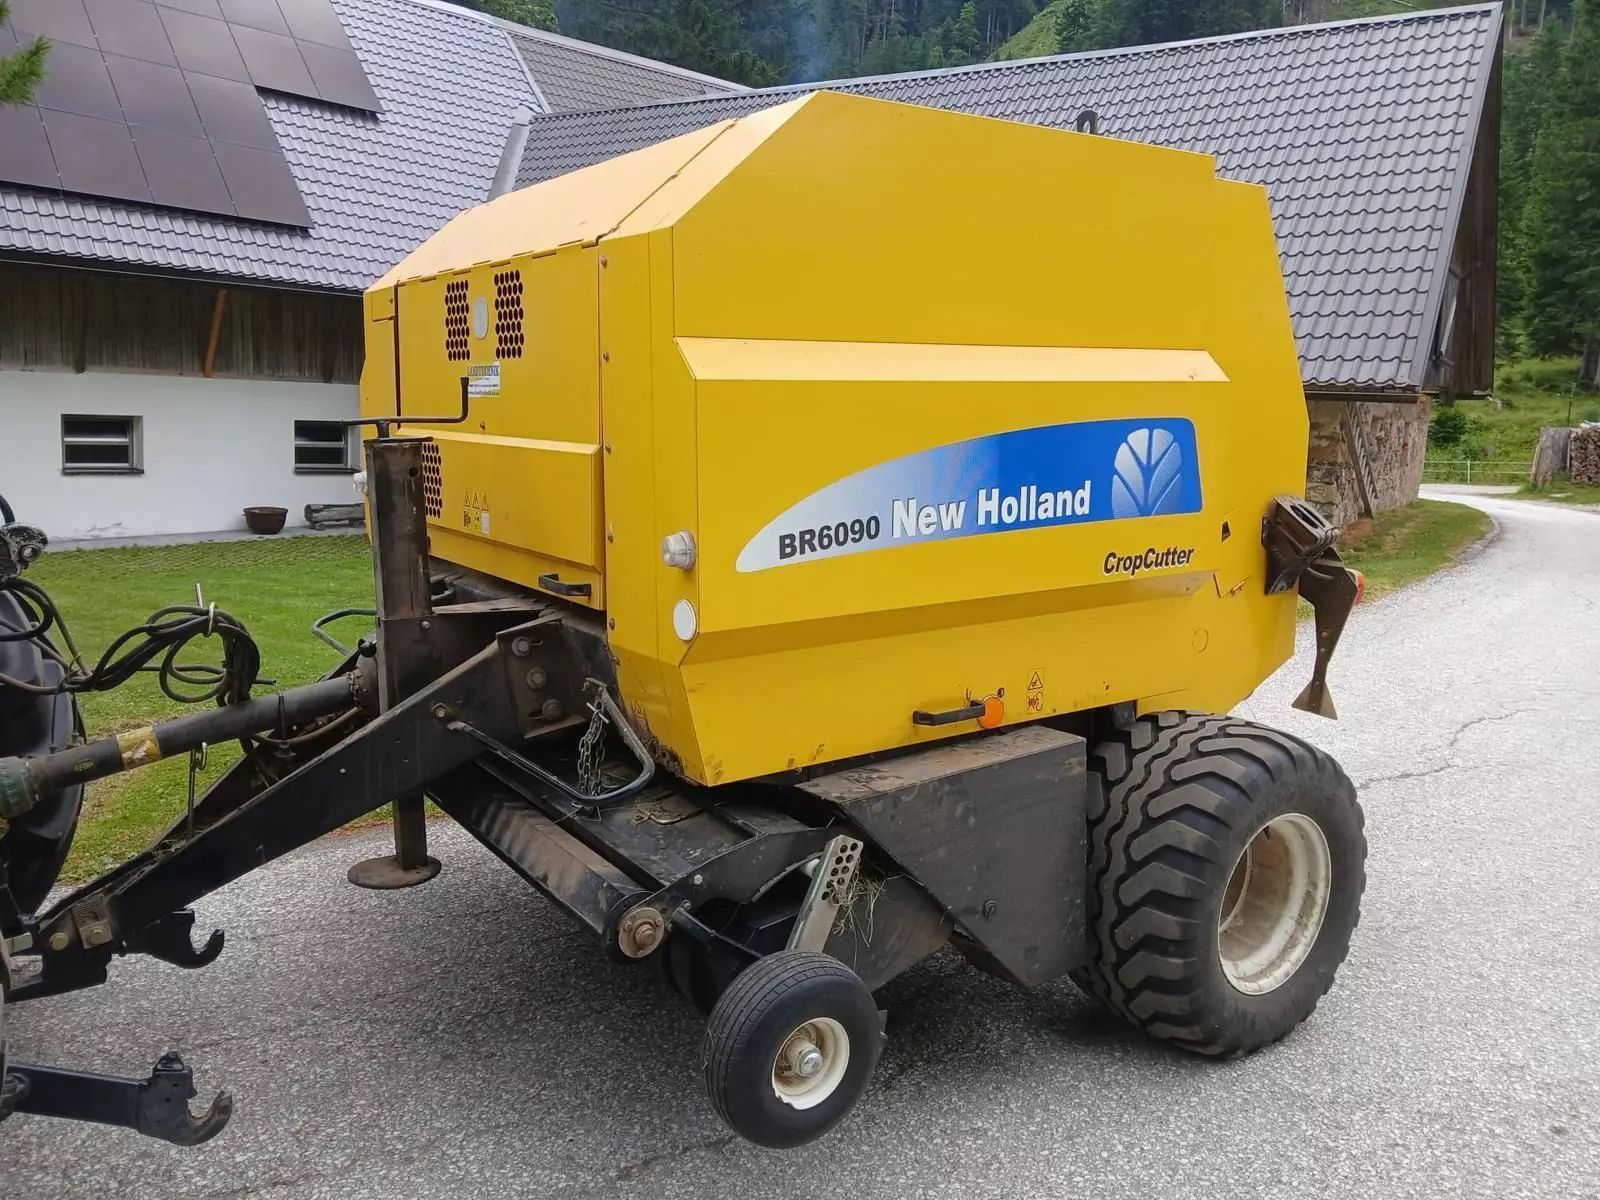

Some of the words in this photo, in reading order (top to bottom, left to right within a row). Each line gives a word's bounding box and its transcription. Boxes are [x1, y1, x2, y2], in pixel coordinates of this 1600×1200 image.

[778, 516, 881, 560] BR6090
[891, 498, 967, 538] New
[977, 480, 1092, 526] Holland
[1103, 546, 1195, 577] CropCutter
